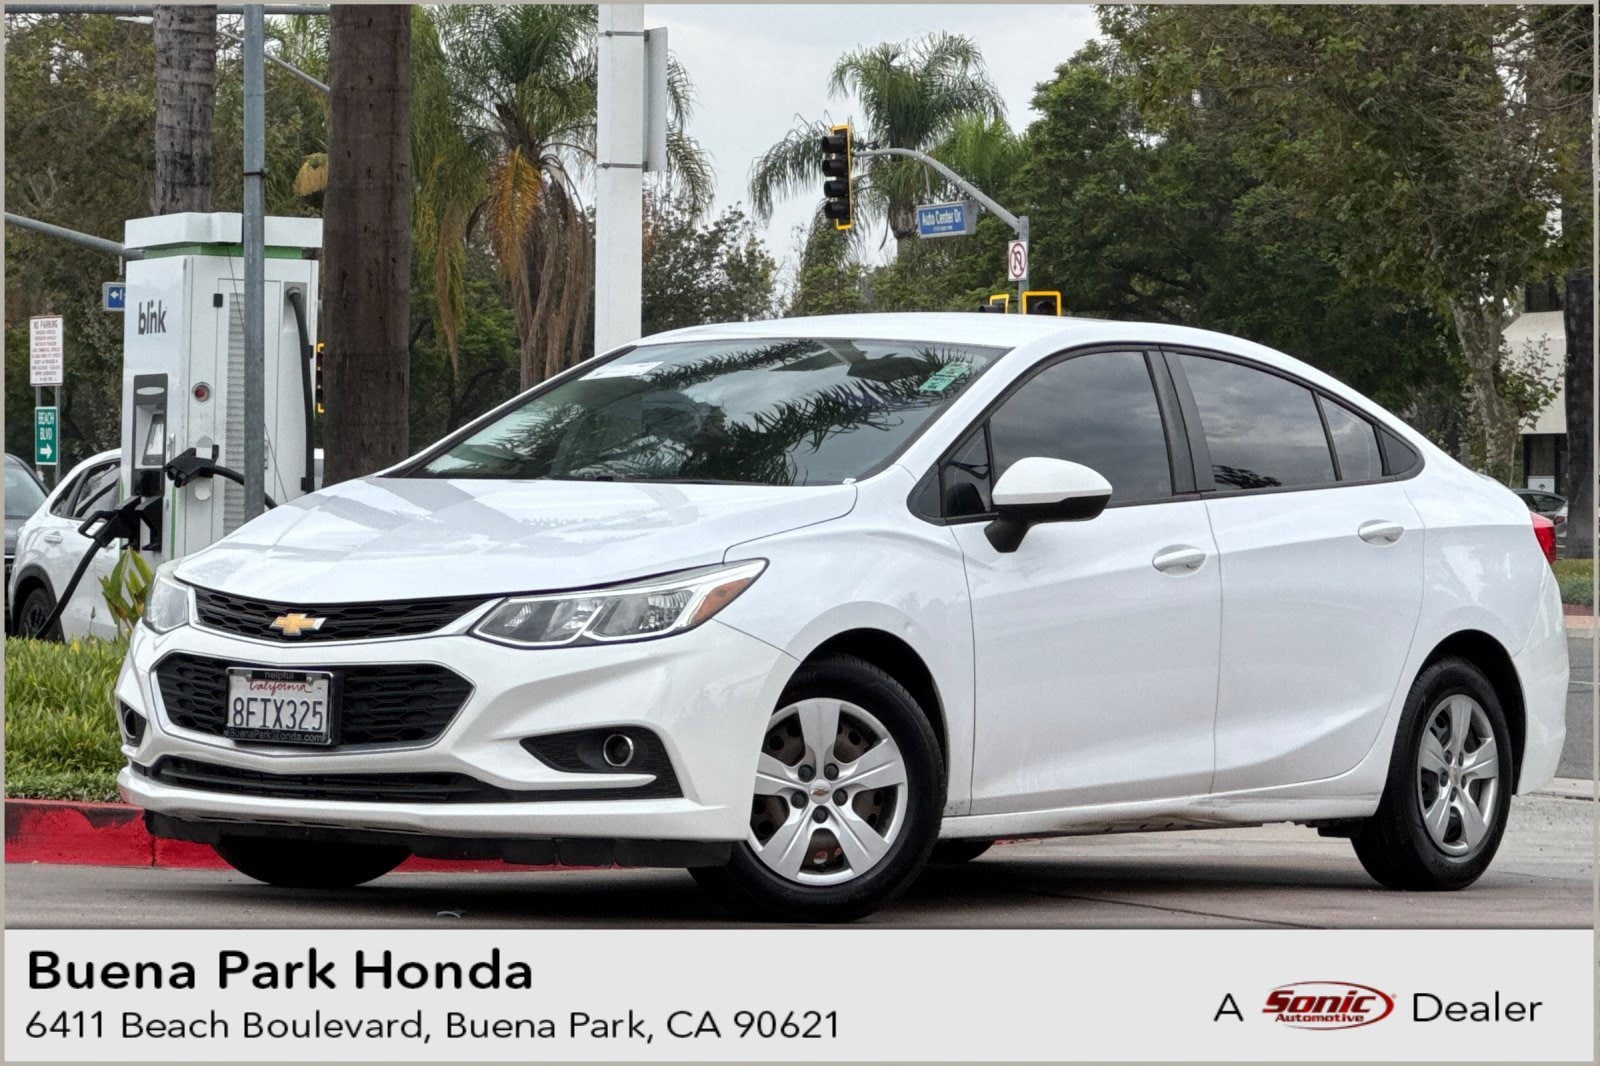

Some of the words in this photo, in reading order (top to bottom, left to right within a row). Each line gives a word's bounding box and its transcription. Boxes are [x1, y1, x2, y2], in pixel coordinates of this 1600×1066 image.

[922, 211, 935, 226] Auto
[935, 209, 954, 225] Center
[954, 208, 962, 223] Dr
[138, 299, 167, 335] blink
[38, 411, 55, 425] BEACH
[39, 427, 53, 441] BLVD
[264, 671, 294, 680] helpful
[249, 680, 313, 696] California
[233, 697, 323, 731] 8FIX325
